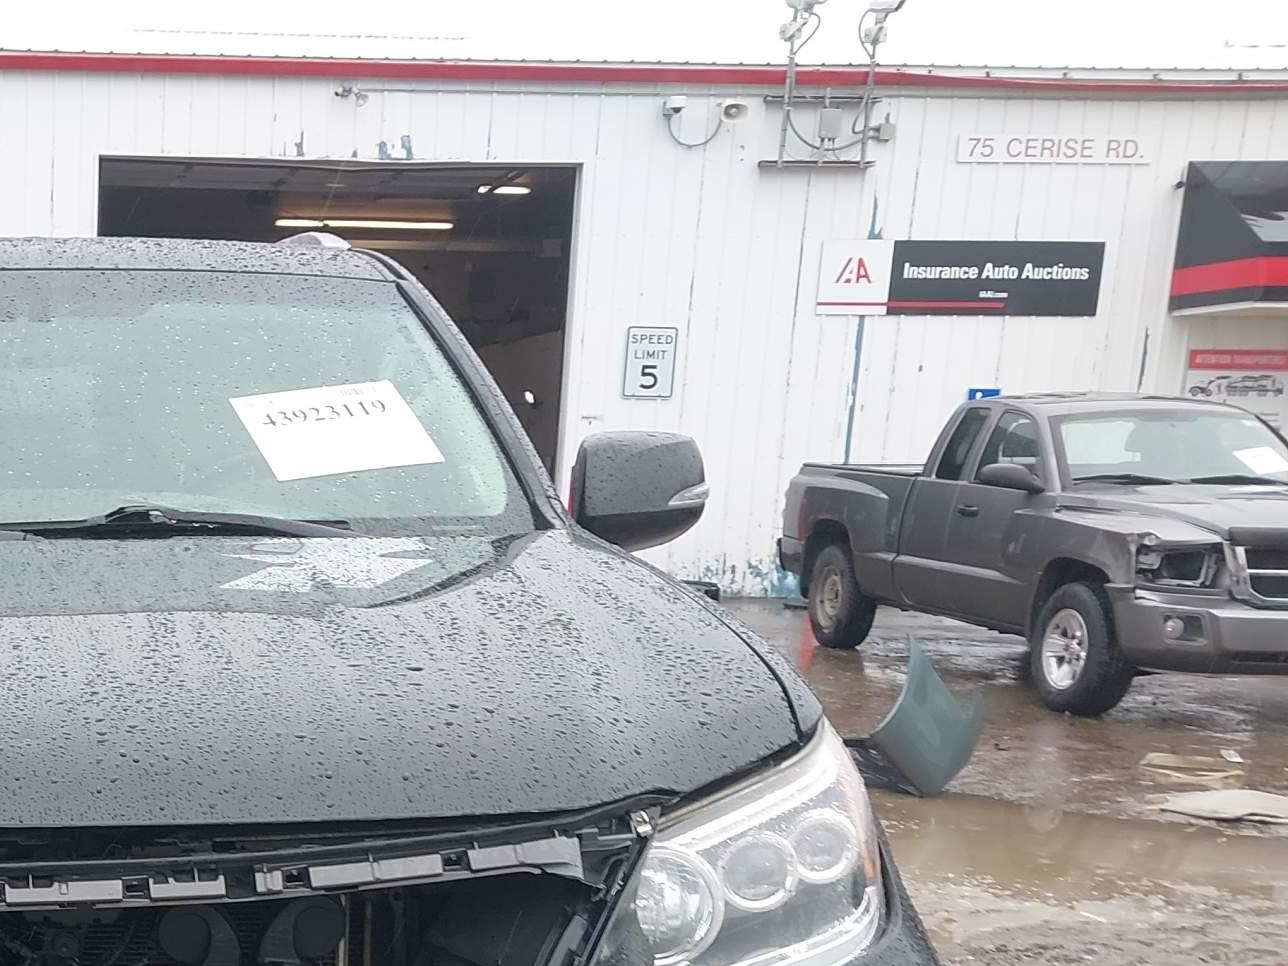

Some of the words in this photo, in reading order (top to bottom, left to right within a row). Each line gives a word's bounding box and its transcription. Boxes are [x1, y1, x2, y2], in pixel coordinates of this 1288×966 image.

[967, 137, 995, 158] 75
[1006, 138, 1095, 159] CERISE
[1105, 139, 1145, 159] RD.
[903, 262, 979, 280] Insurance
[981, 262, 1019, 280] Auto
[1021, 262, 1090, 280] Auctions
[631, 334, 674, 345] SPEED
[634, 349, 668, 360] LIMIT
[639, 364, 658, 390] 5
[263, 399, 387, 427] 43923119
